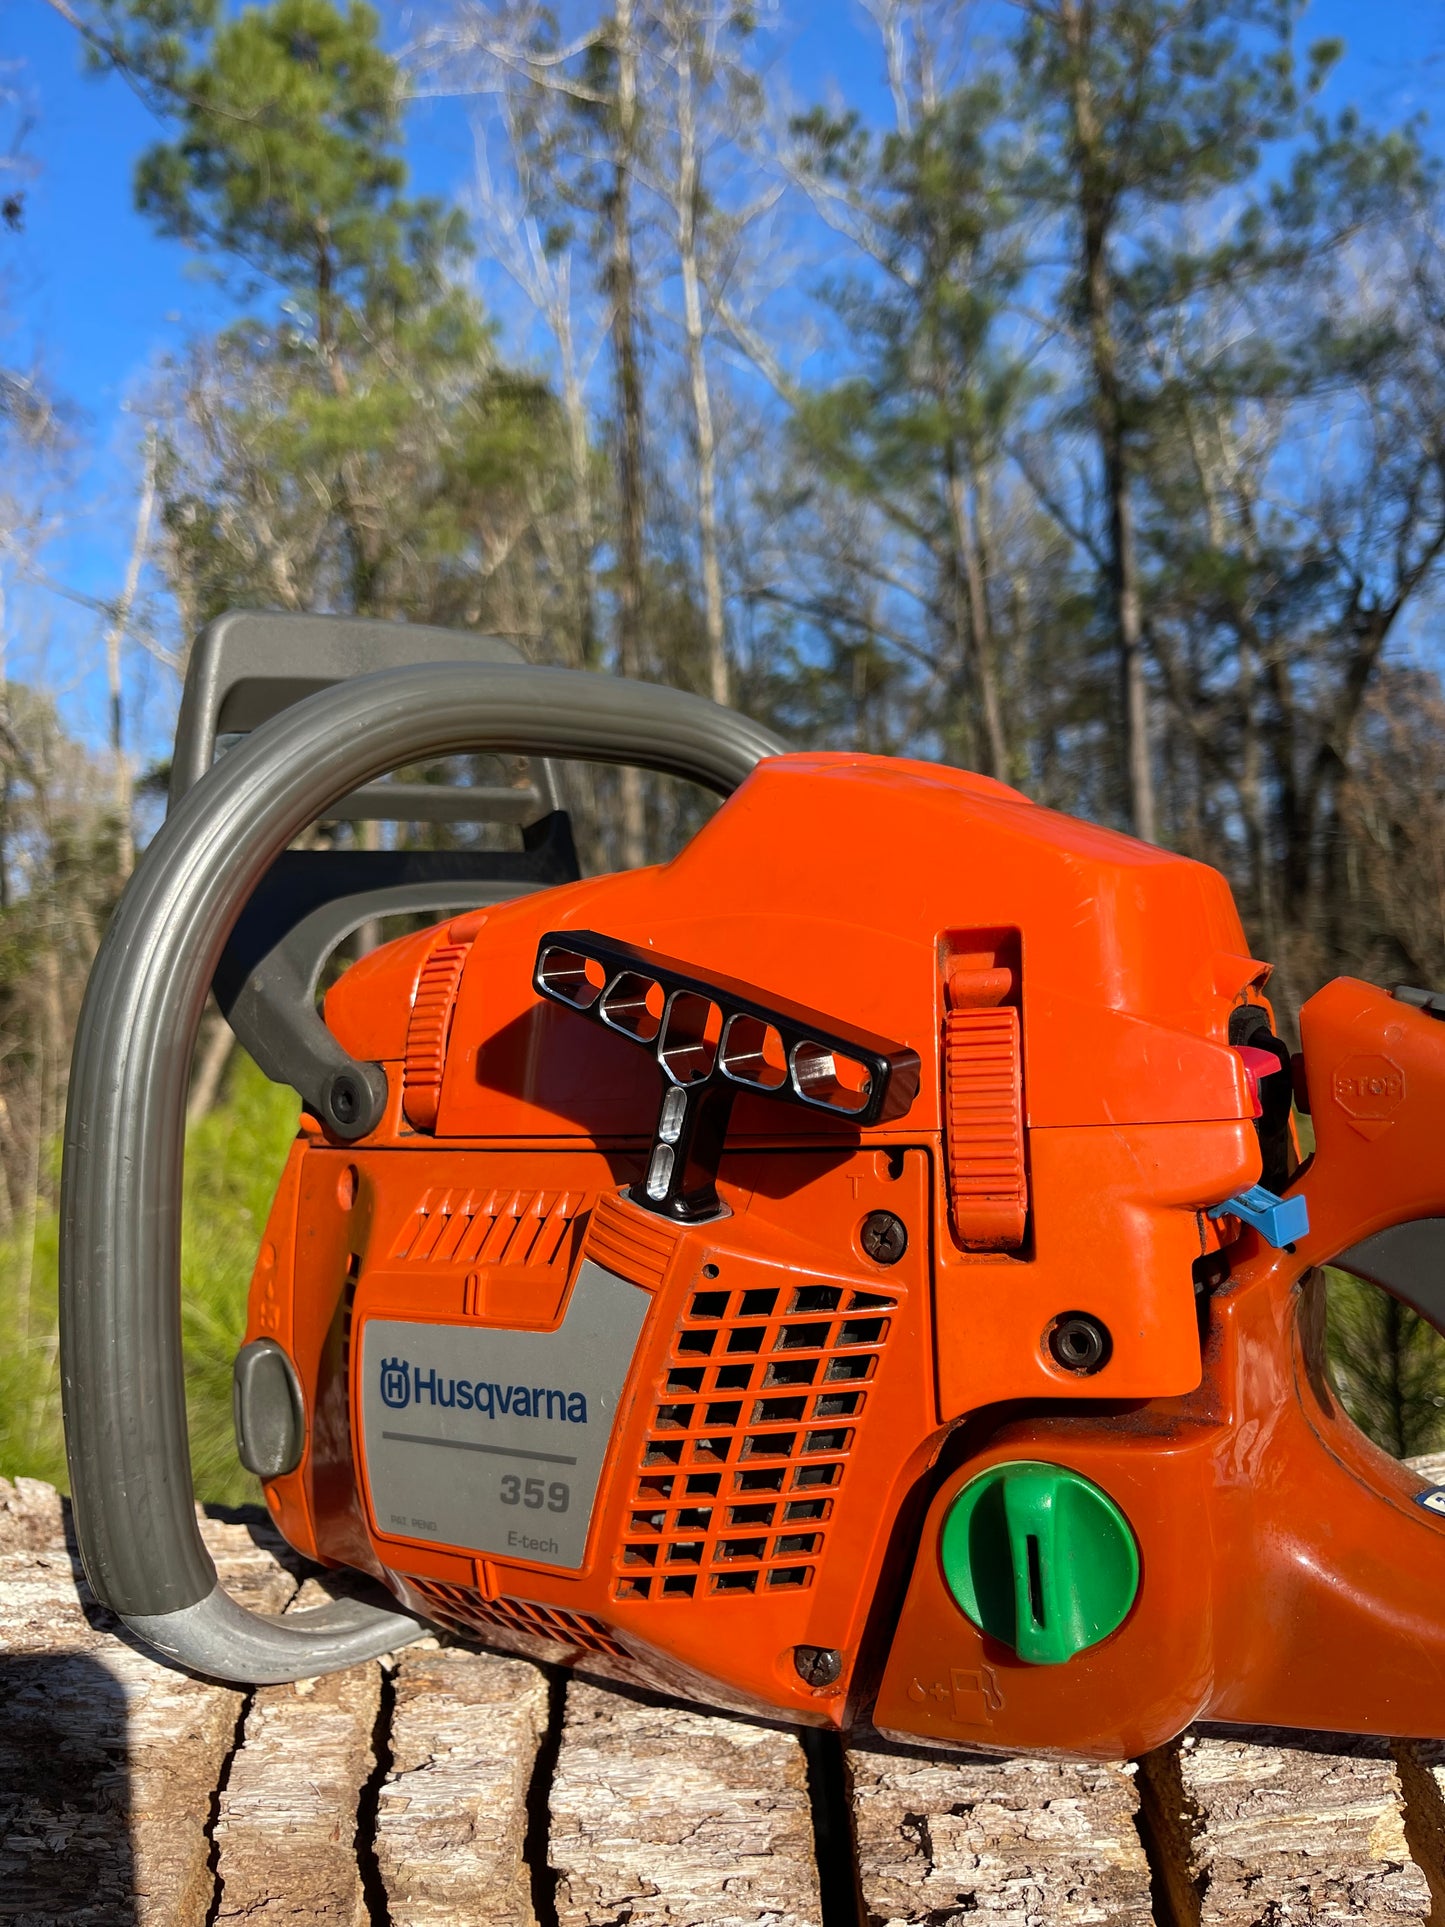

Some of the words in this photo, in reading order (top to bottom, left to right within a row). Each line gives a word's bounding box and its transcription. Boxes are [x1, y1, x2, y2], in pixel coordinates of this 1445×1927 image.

[1336, 1076, 1401, 1096] STOP
[846, 1173, 864, 1200] T
[414, 1367, 588, 1423] Husqvarna
[500, 1475, 570, 1513] 359
[507, 1530, 559, 1554] E-tech
